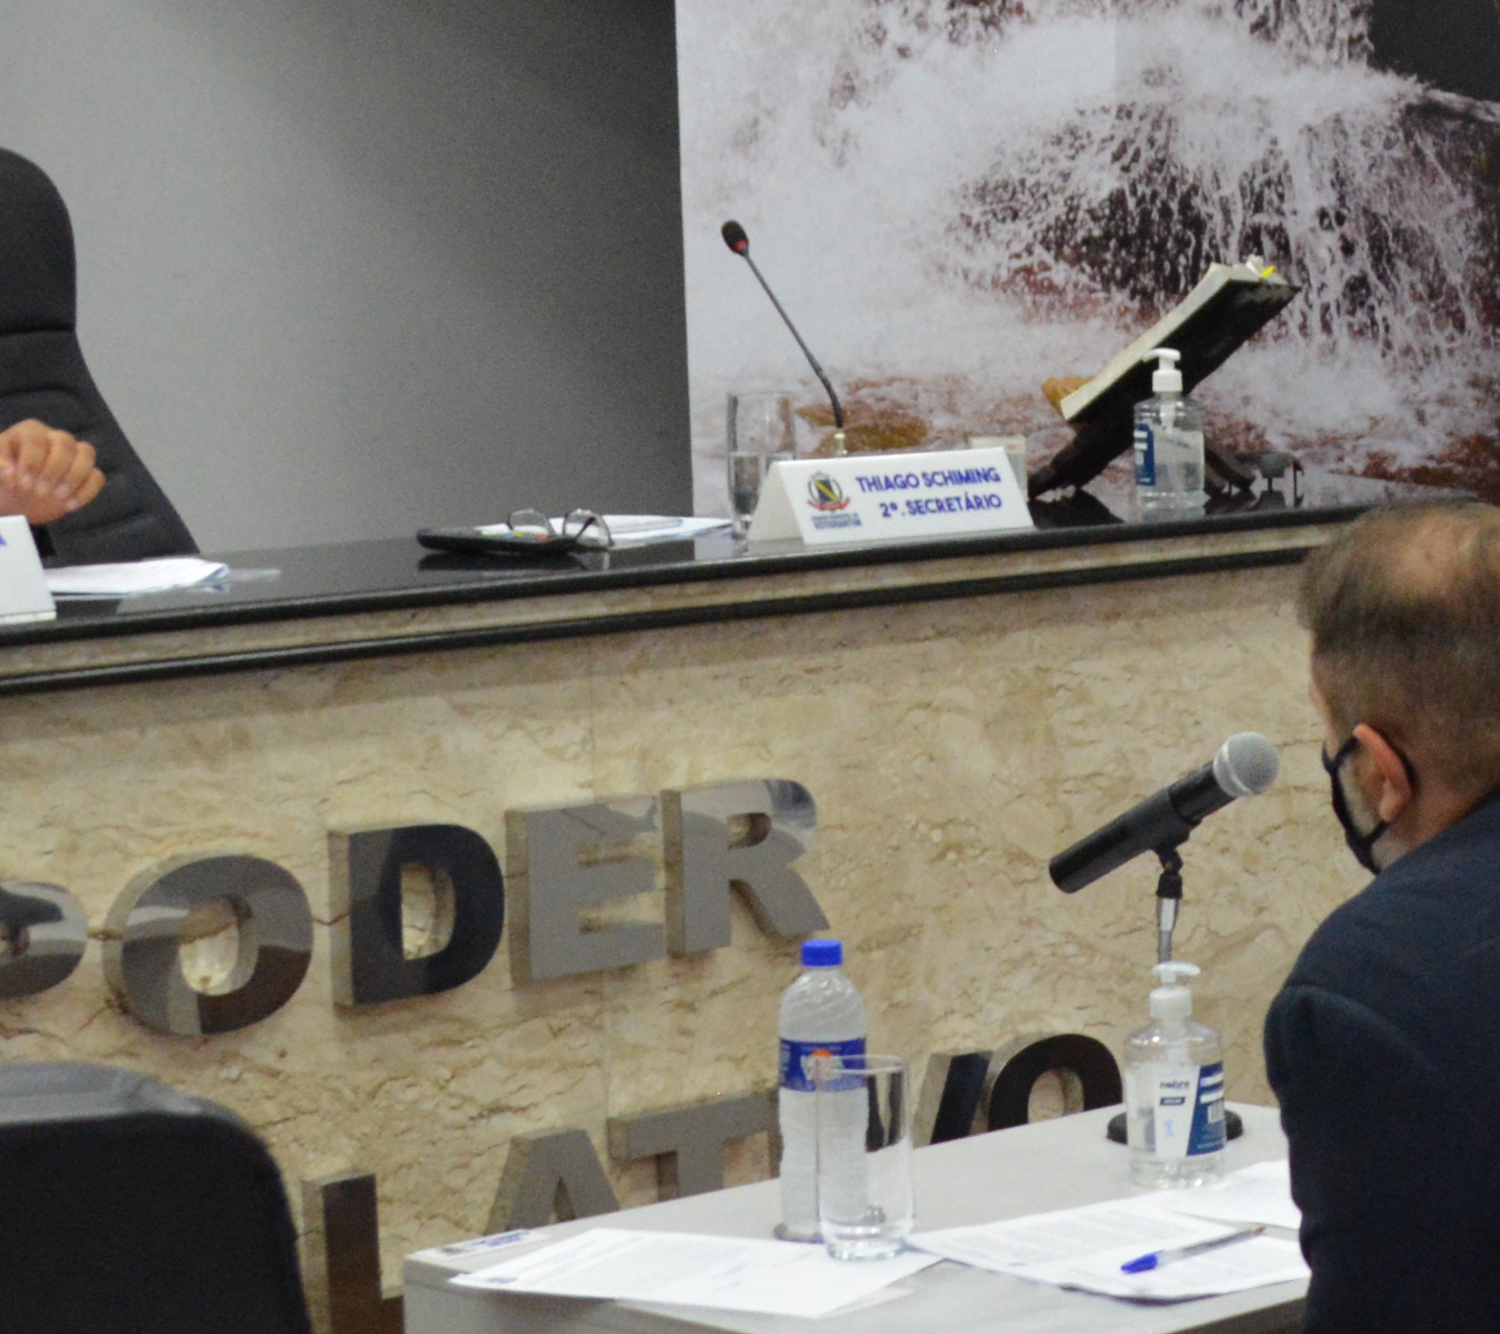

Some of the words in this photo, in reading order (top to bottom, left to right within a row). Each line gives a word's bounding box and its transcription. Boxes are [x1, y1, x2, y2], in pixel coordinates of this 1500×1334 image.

[855, 471, 920, 493] THIAGO
[923, 467, 1002, 488] SCHIMING
[906, 492, 1002, 516] SECRETÁRIO
